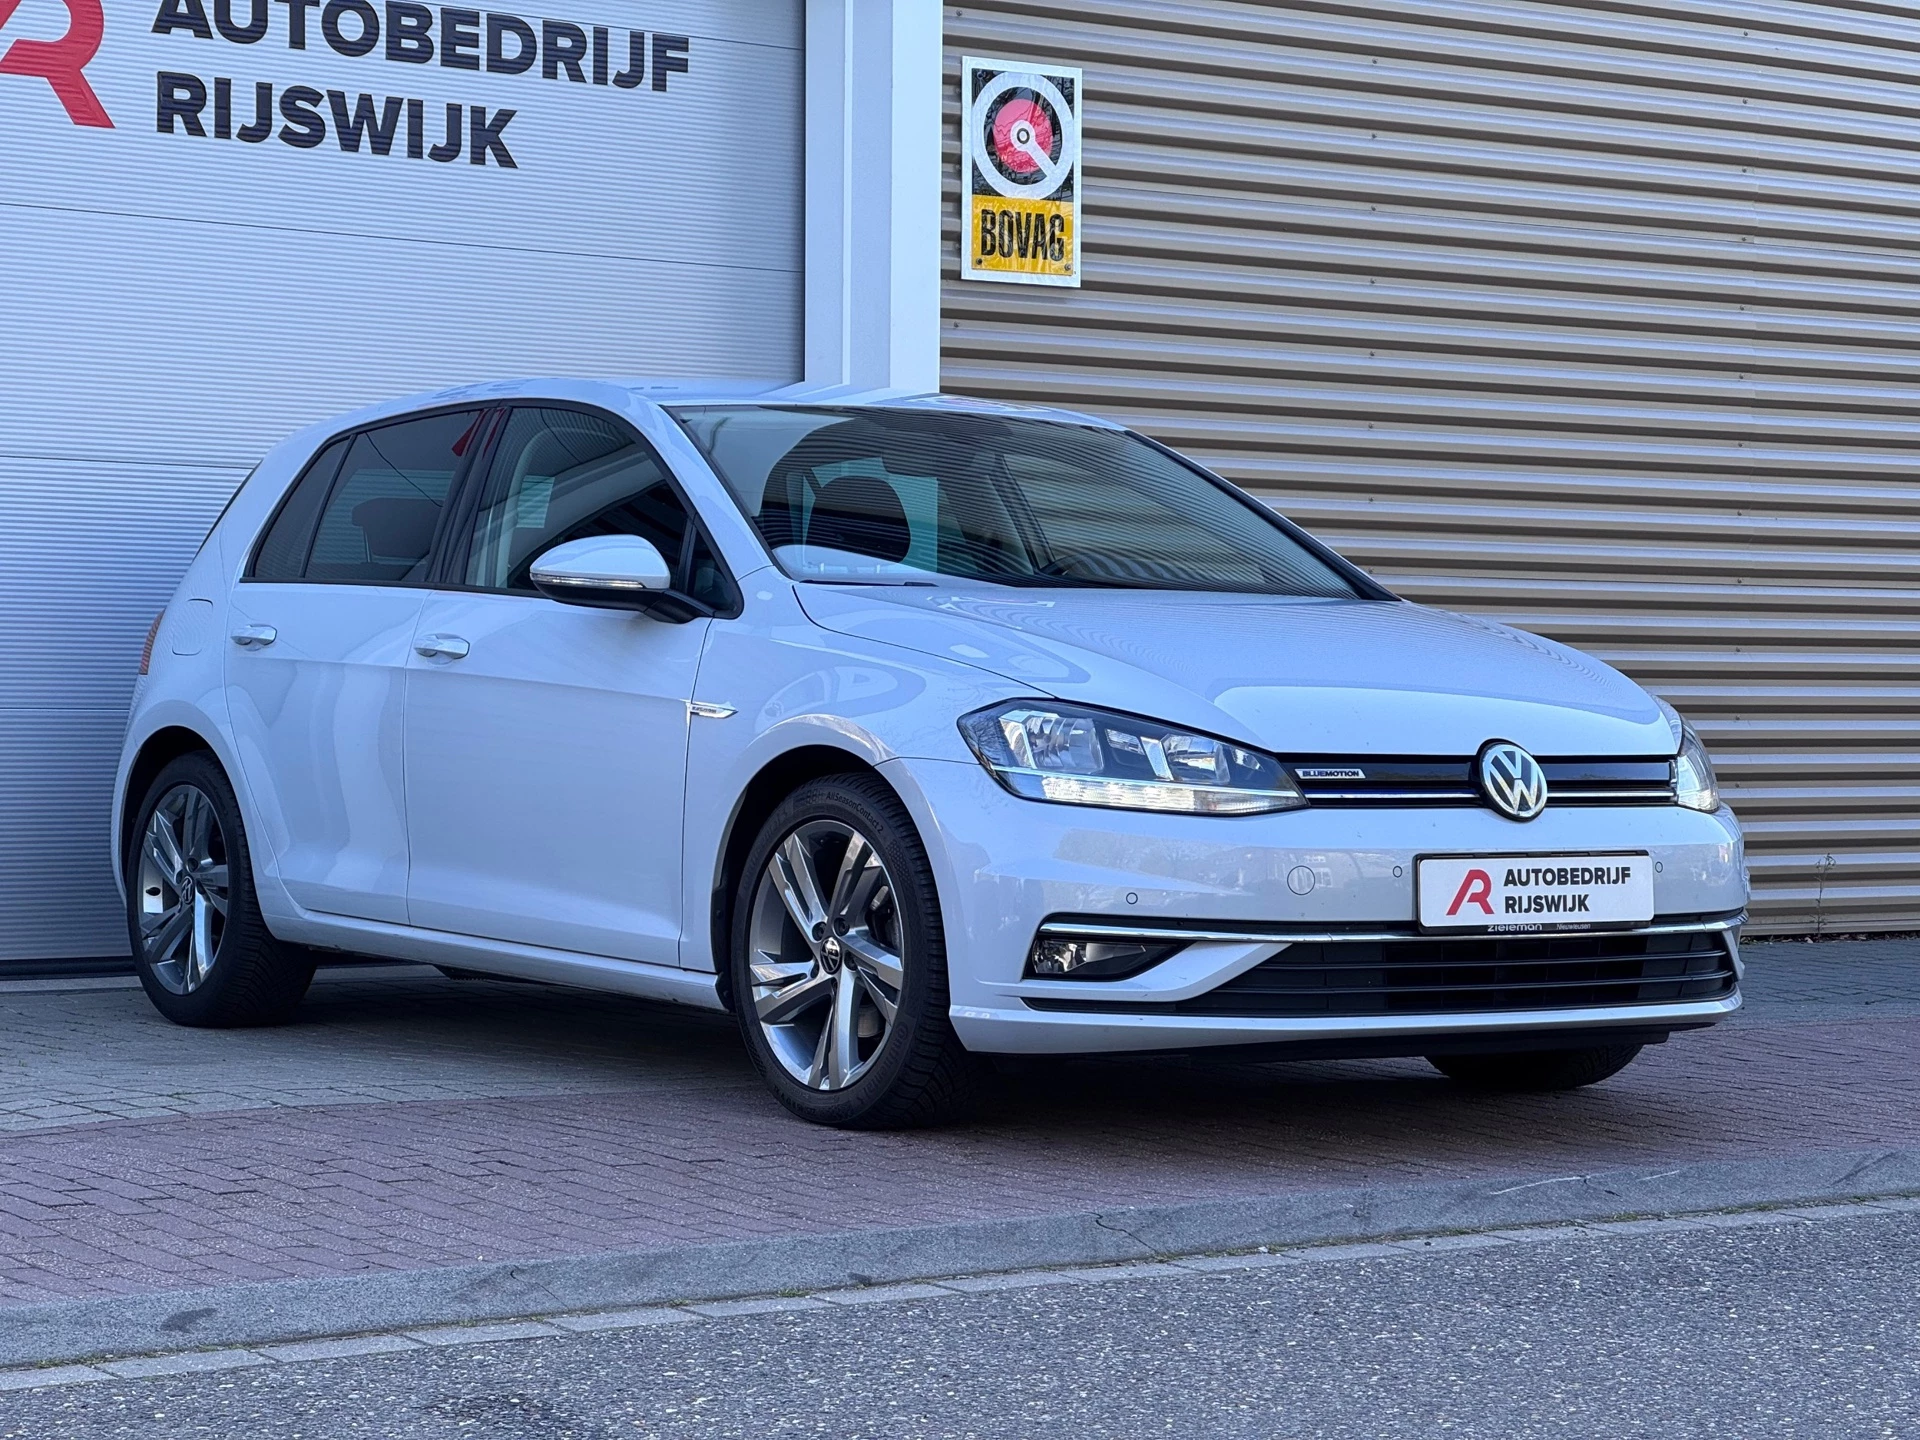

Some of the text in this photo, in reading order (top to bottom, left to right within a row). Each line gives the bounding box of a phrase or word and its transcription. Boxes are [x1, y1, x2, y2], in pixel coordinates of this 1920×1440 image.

[151, 0, 690, 92] AUTOBEDRIJF
[156, 71, 519, 169] RIJSWIJK
[980, 208, 1065, 262] BOVAG
[1503, 866, 1632, 887] AUTOBEDRIJF
[1504, 894, 1590, 914] RIJSWIJK
